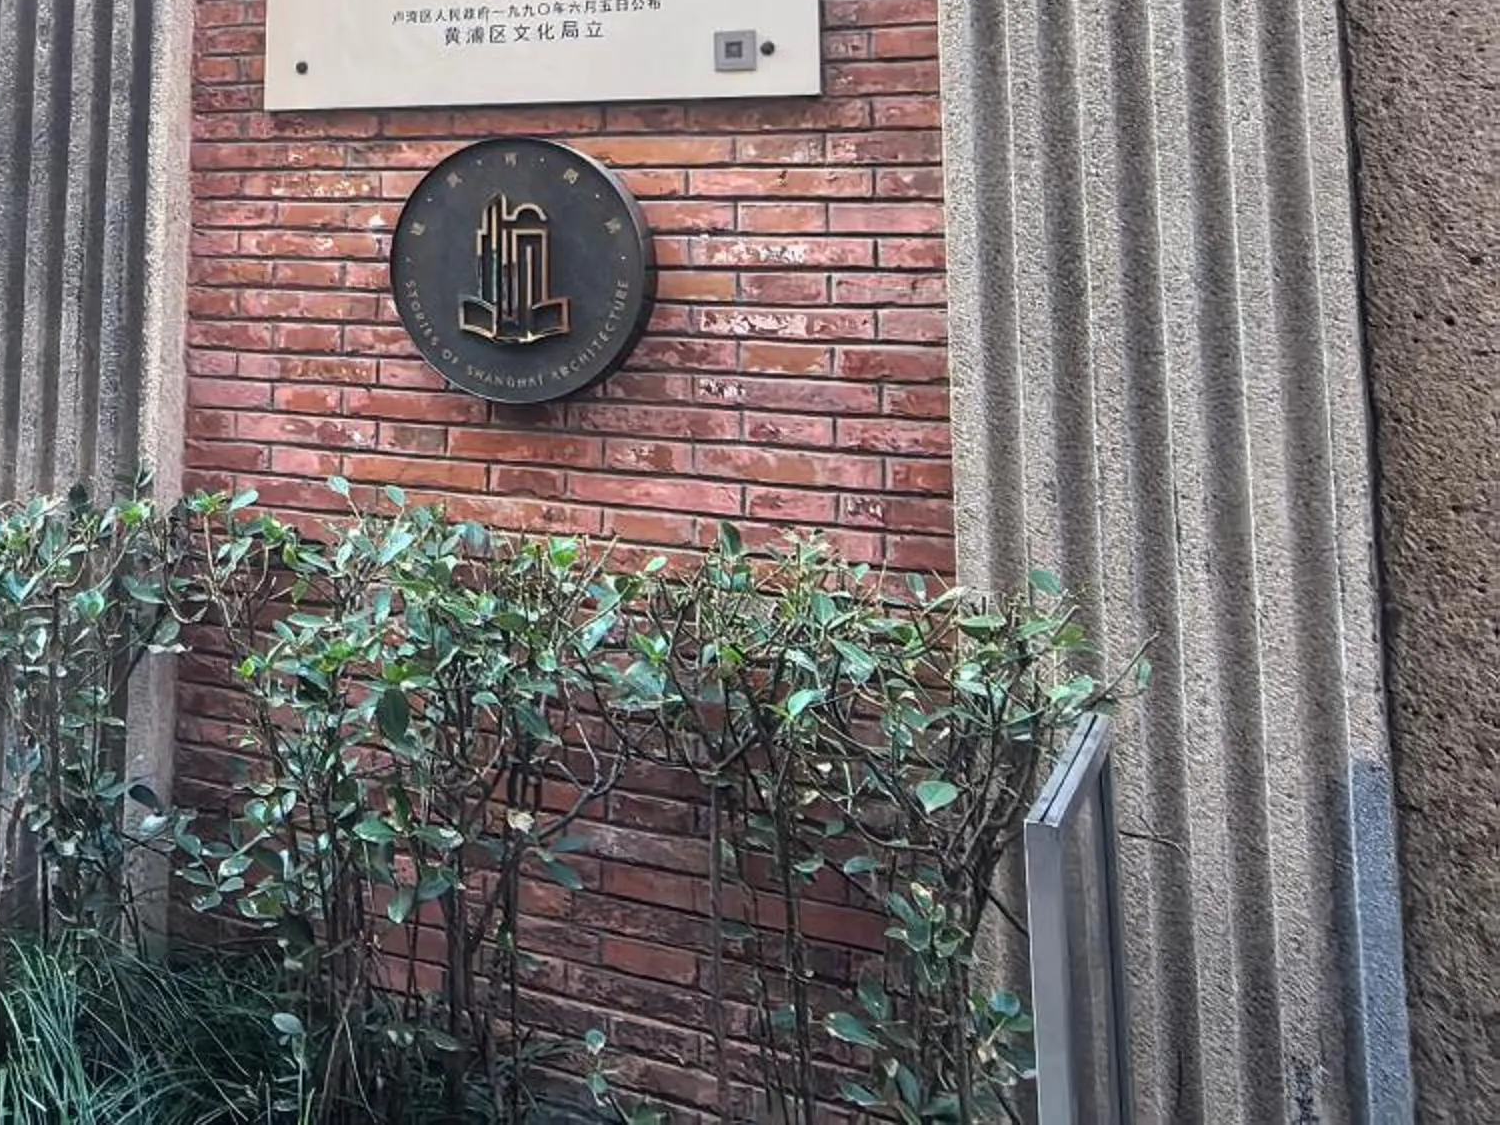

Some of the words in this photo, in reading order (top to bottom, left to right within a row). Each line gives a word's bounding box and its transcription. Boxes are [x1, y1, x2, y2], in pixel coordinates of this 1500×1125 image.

[443, 20, 605, 47] 黄浦区文化局立
